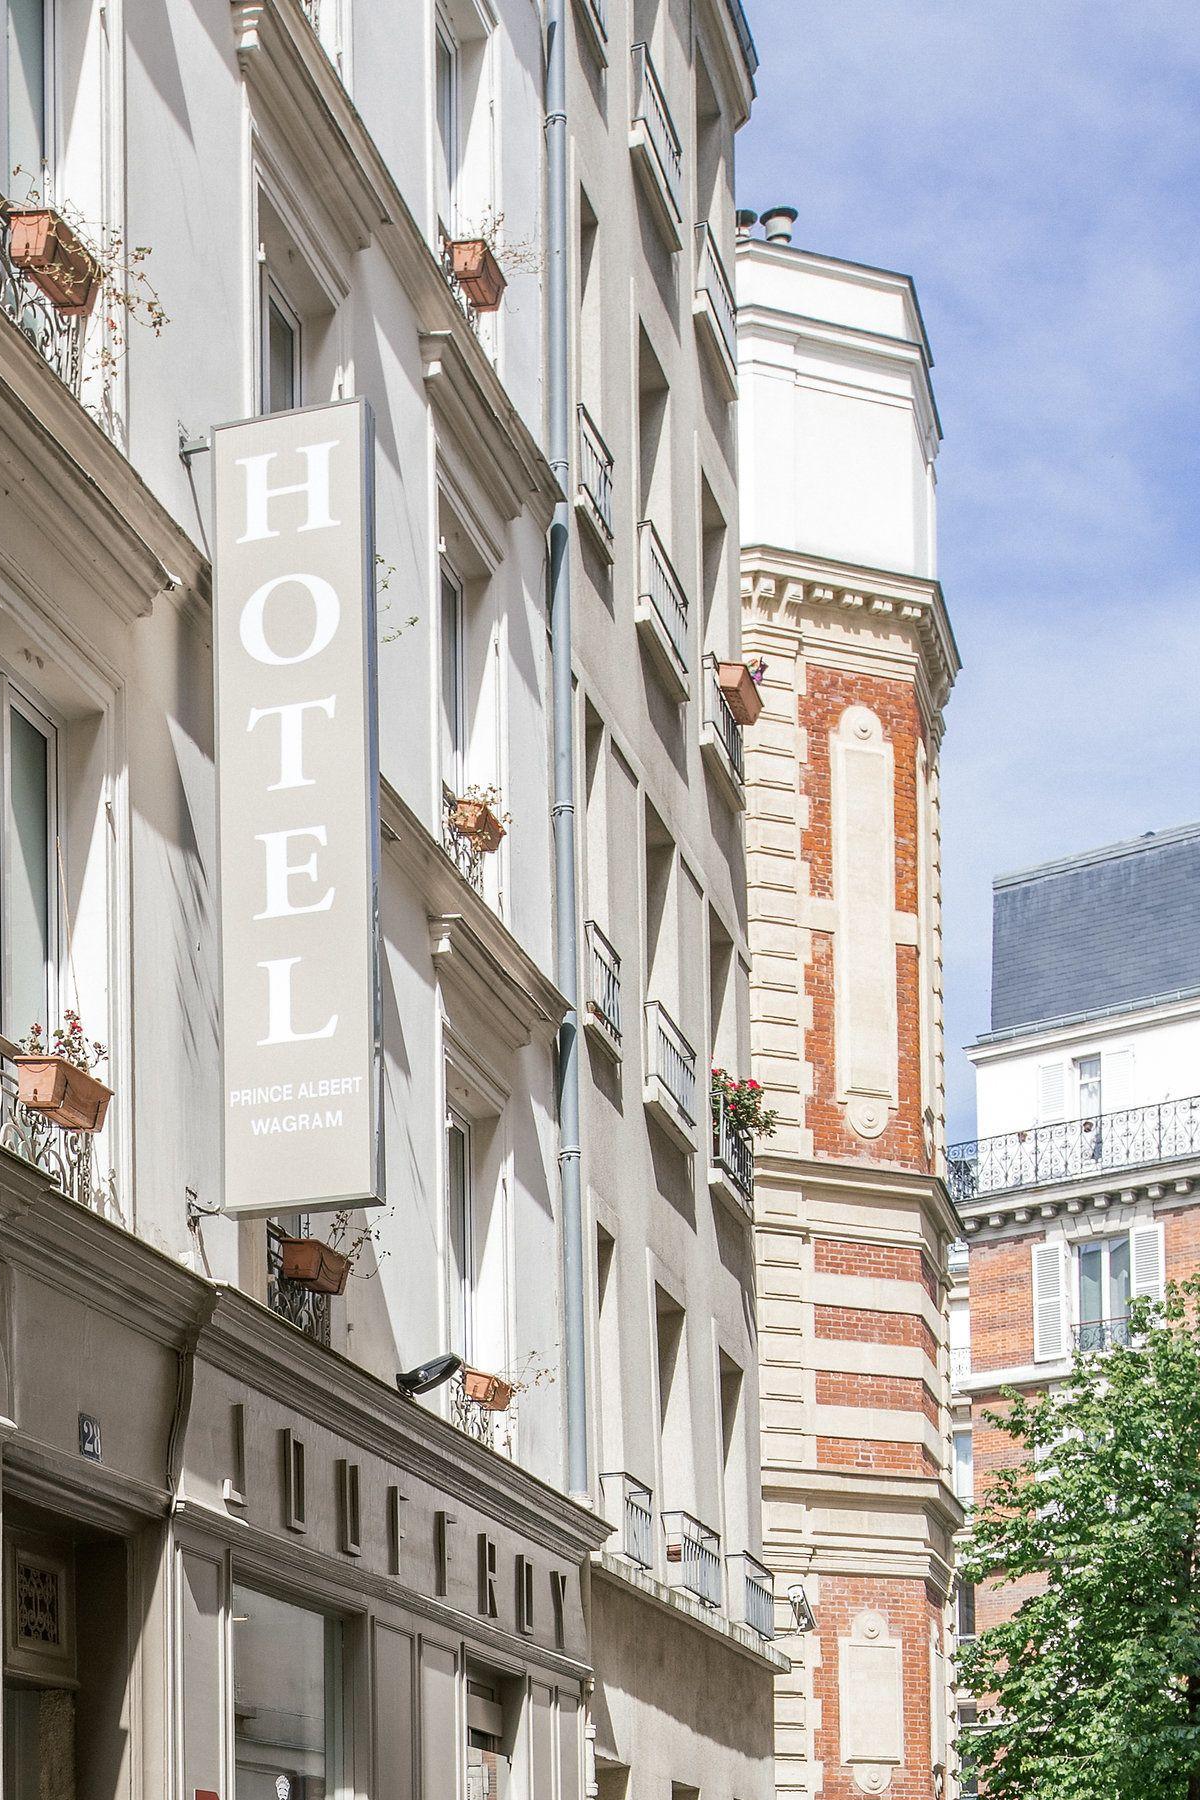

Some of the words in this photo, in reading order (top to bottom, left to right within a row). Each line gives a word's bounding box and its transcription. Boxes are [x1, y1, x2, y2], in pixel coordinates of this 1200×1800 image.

[234, 439, 342, 1047] HOTEL
[229, 1083, 294, 1108] PRINCE
[297, 1076, 363, 1100] ALBERT
[250, 1109, 343, 1136] WAGRAM
[83, 1420, 101, 1455] 28
